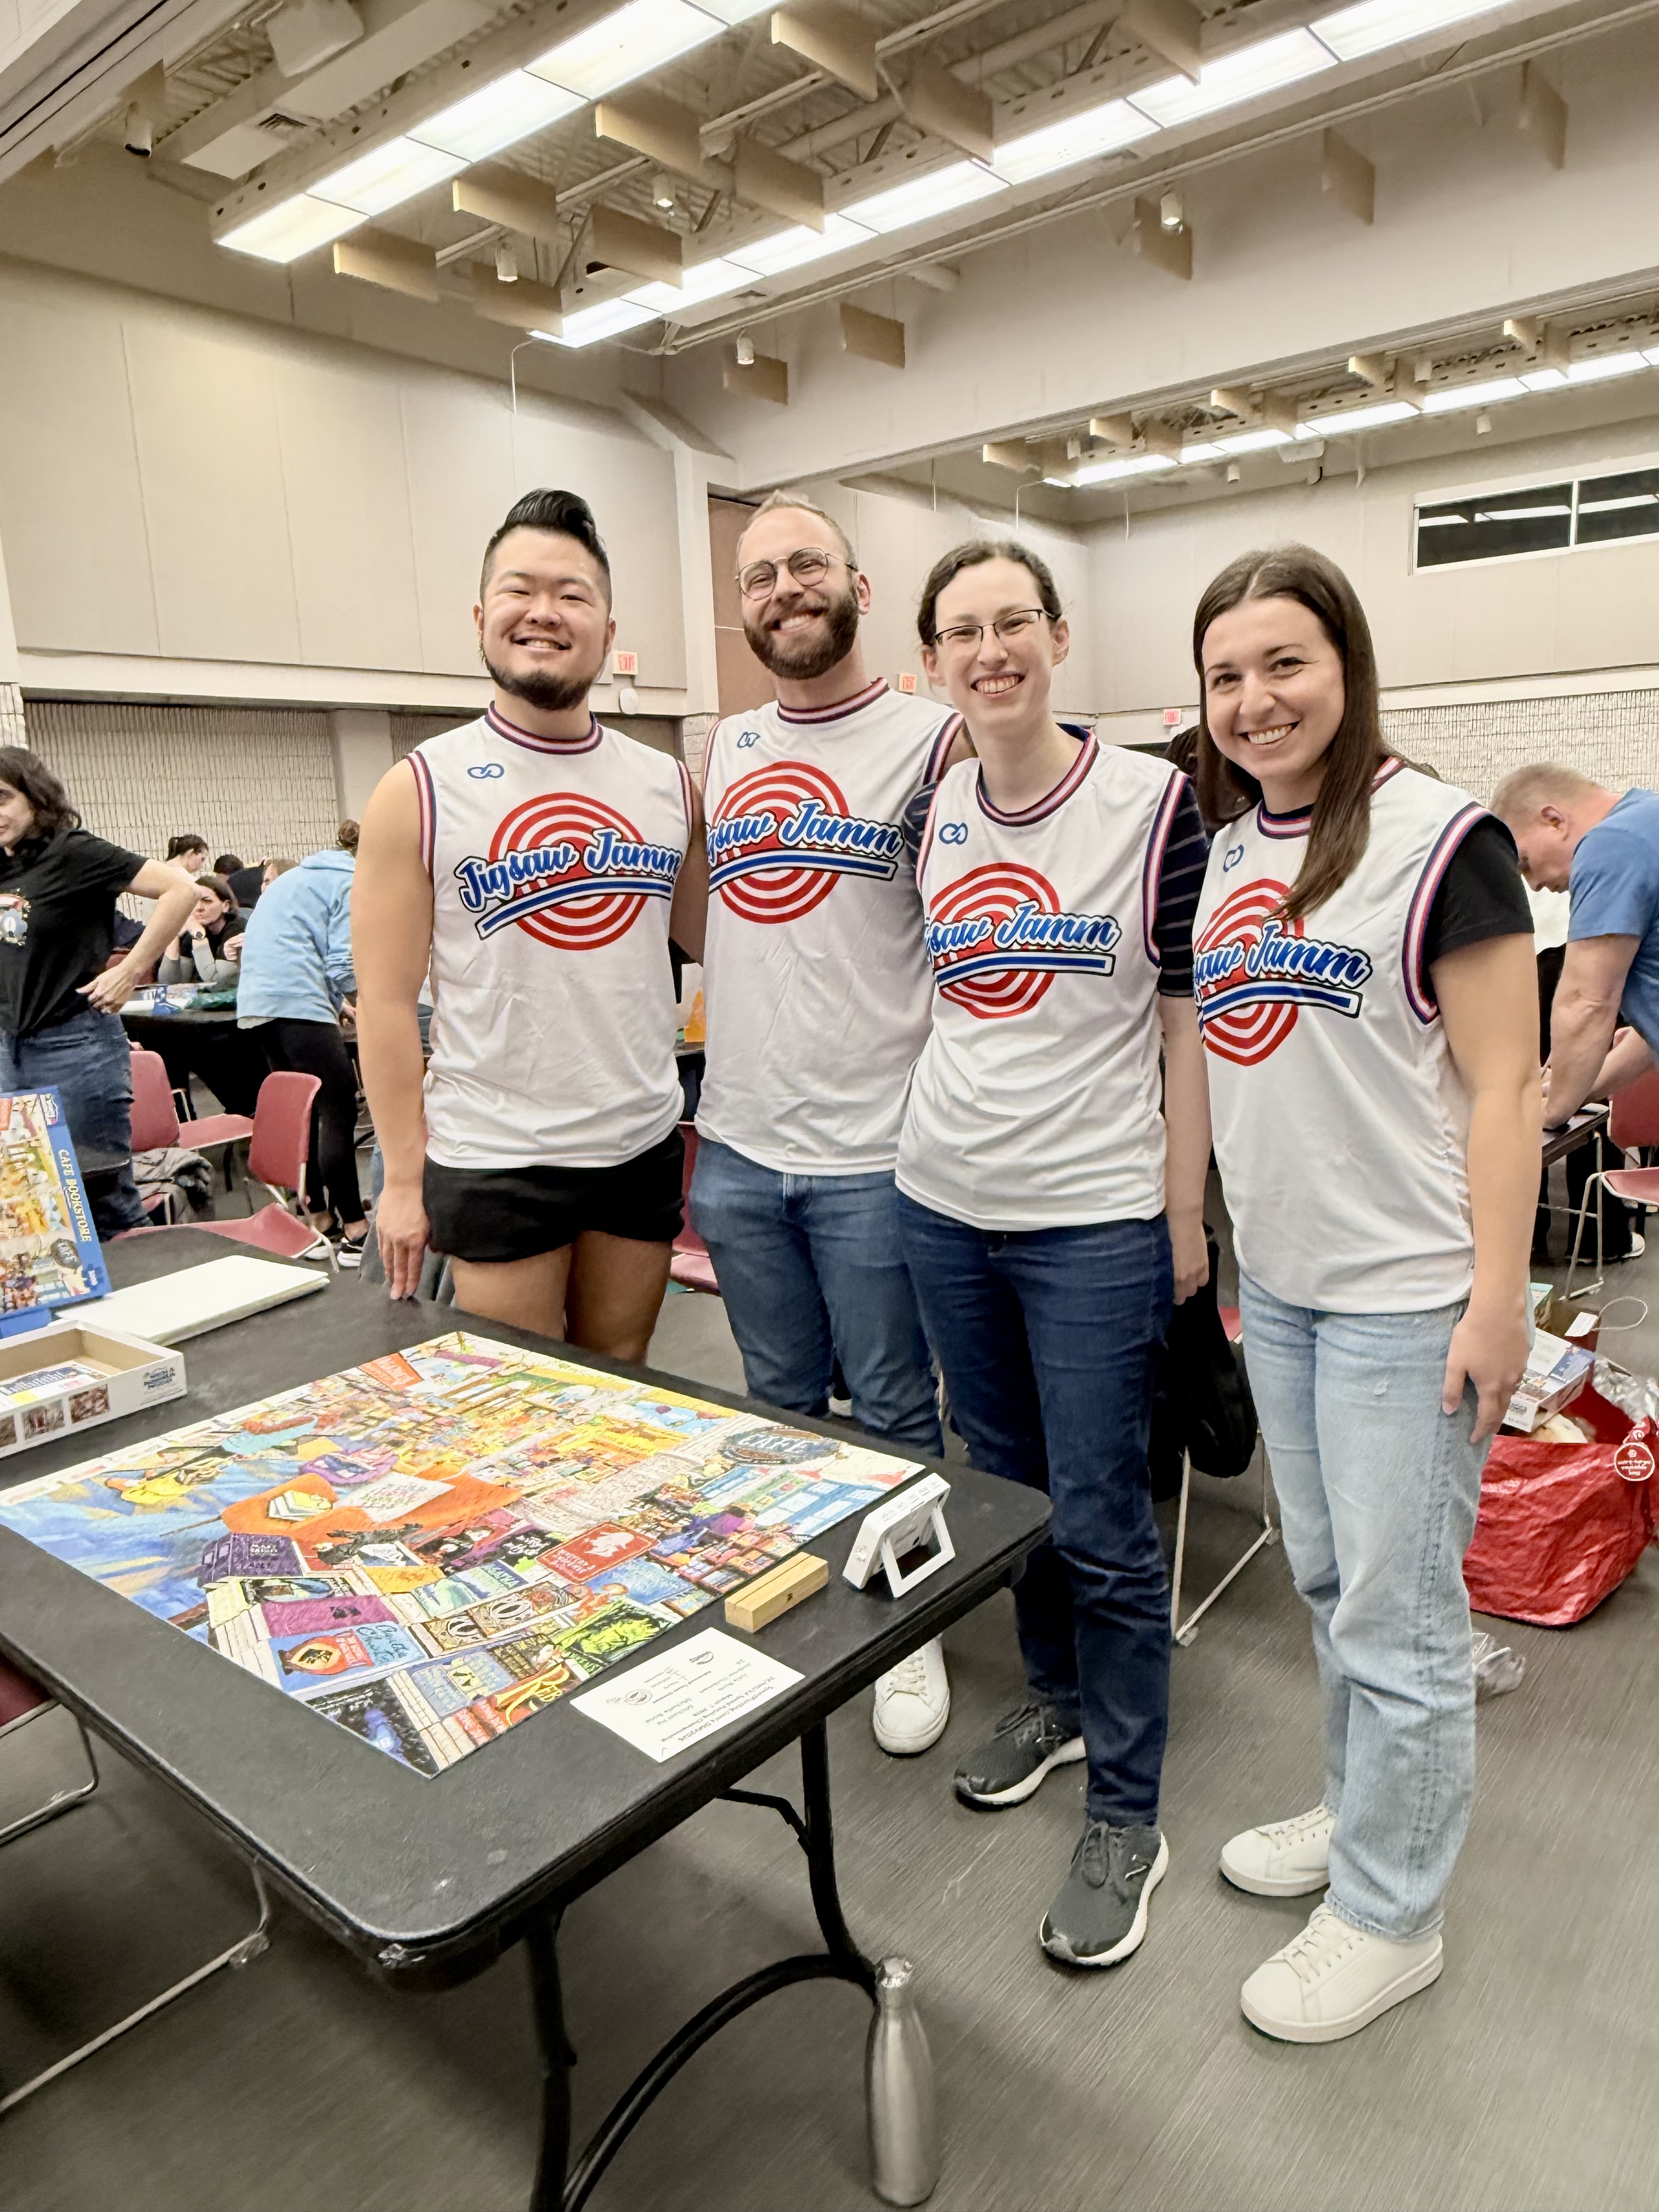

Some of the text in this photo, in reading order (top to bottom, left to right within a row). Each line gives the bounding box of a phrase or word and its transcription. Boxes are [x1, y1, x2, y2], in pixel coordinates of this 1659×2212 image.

[781, 801, 904, 859] Jamm
[457, 830, 681, 910] Jigsaw Jamm
[996, 904, 1118, 951] Jamm
[1246, 923, 1371, 985] Jamm
[66, 1178, 92, 1242] BOOKSTORE
